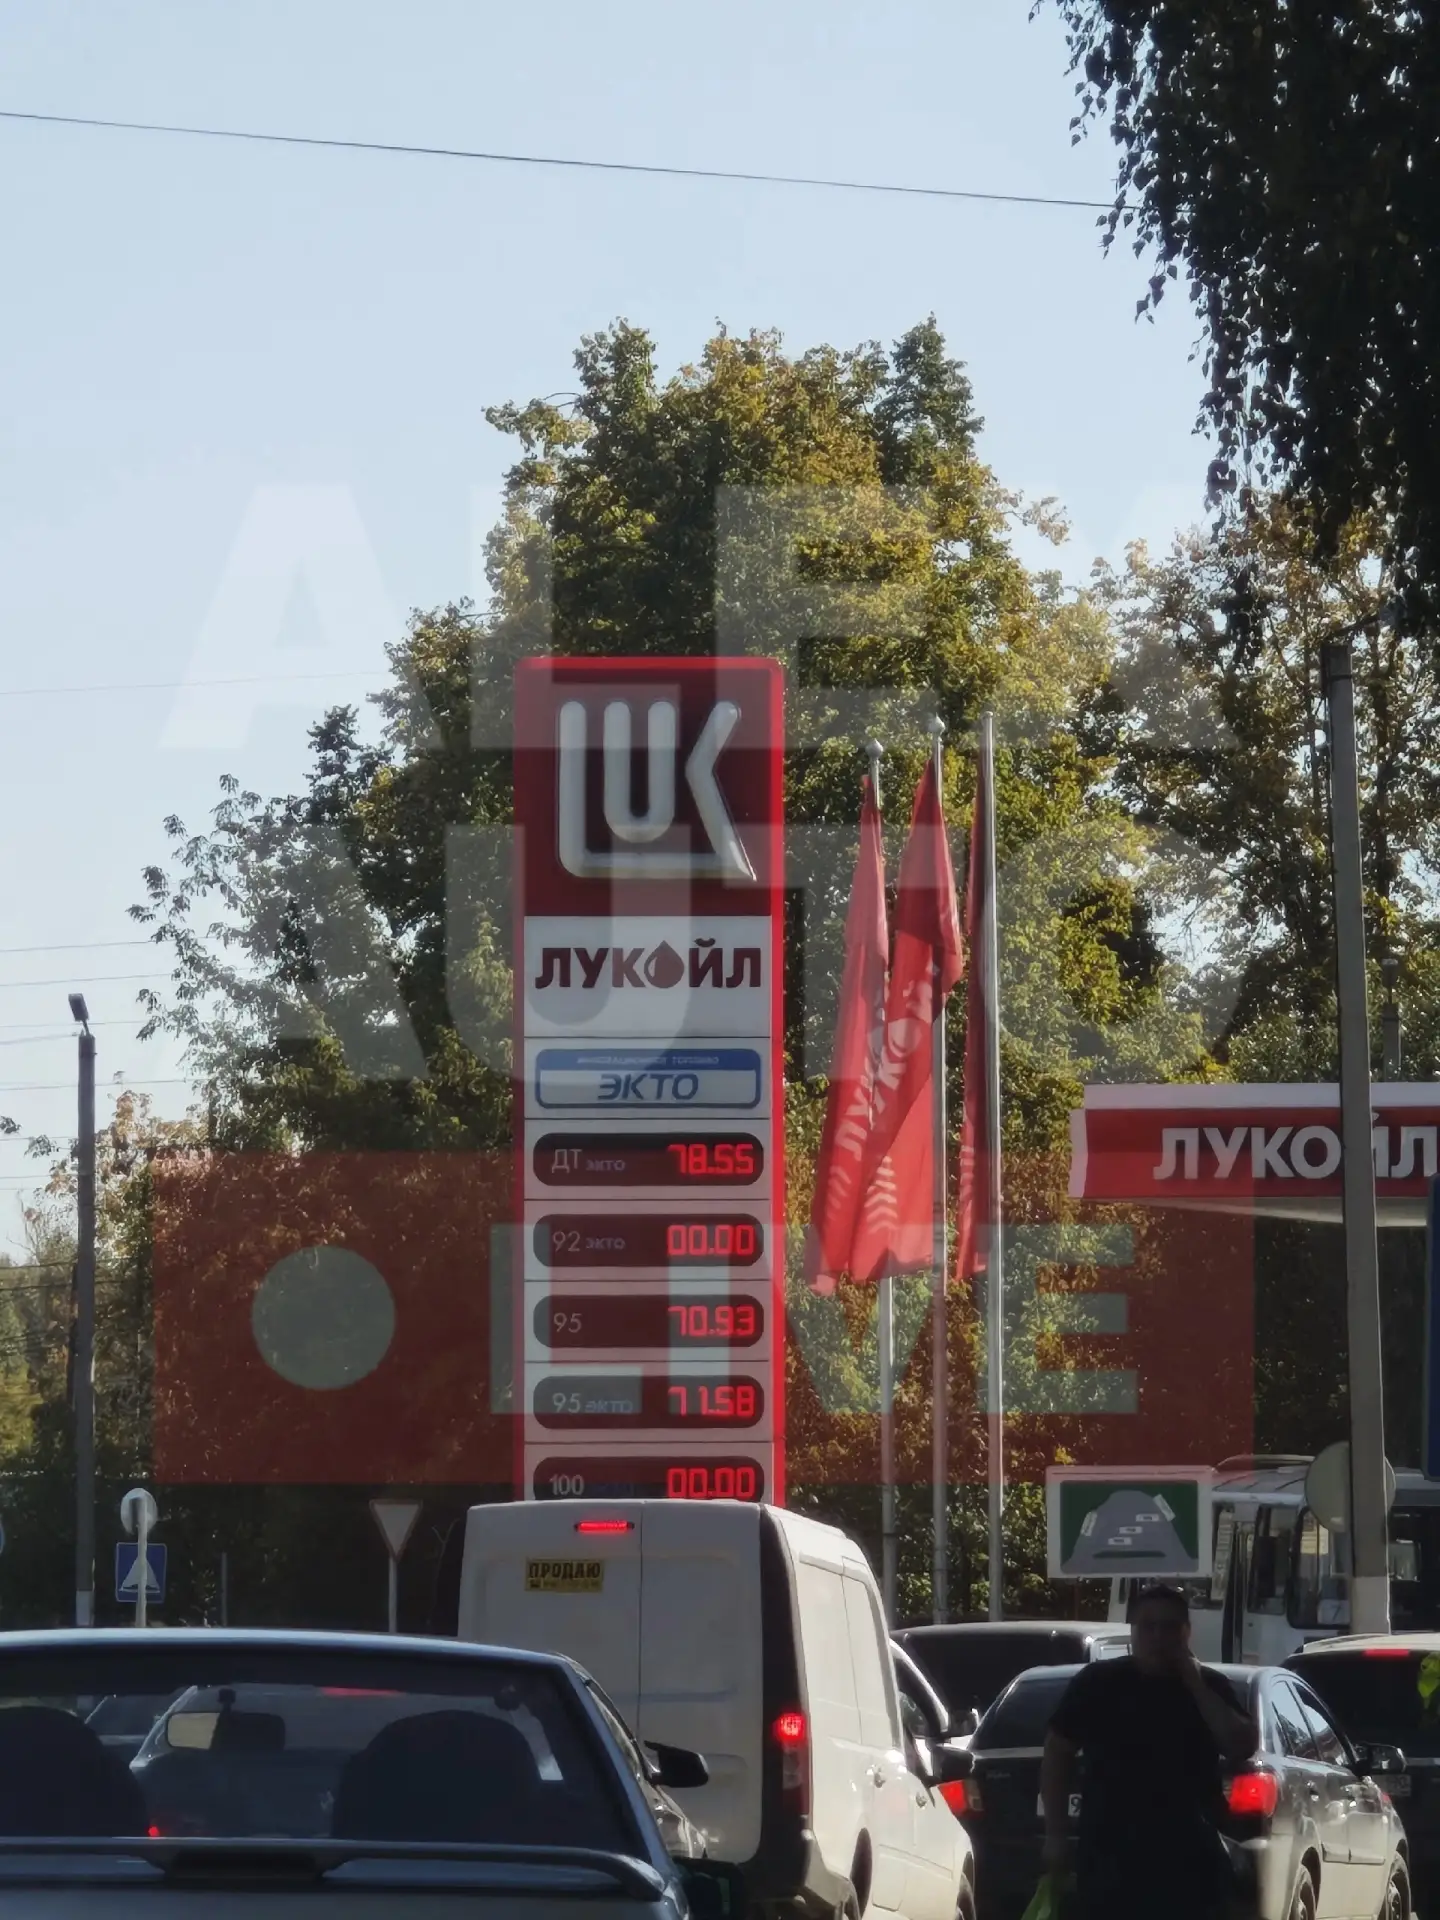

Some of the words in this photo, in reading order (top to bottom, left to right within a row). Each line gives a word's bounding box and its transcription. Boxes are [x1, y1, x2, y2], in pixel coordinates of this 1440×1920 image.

[535, 938, 761, 989] ЛУКОЙЛ
[597, 1073, 699, 1101] ЭКТО
[551, 1149, 582, 1173] ДТ
[552, 1230, 581, 1252] 92
[666, 1224, 756, 1257] 00.00
[553, 1312, 582, 1333] 95
[667, 1305, 756, 1337] 70.93
[552, 1392, 581, 1414] 95
[549, 1474, 585, 1496] 100
[666, 1467, 756, 1499] 00.00
[528, 1562, 602, 1580] ПРОДАЮ
